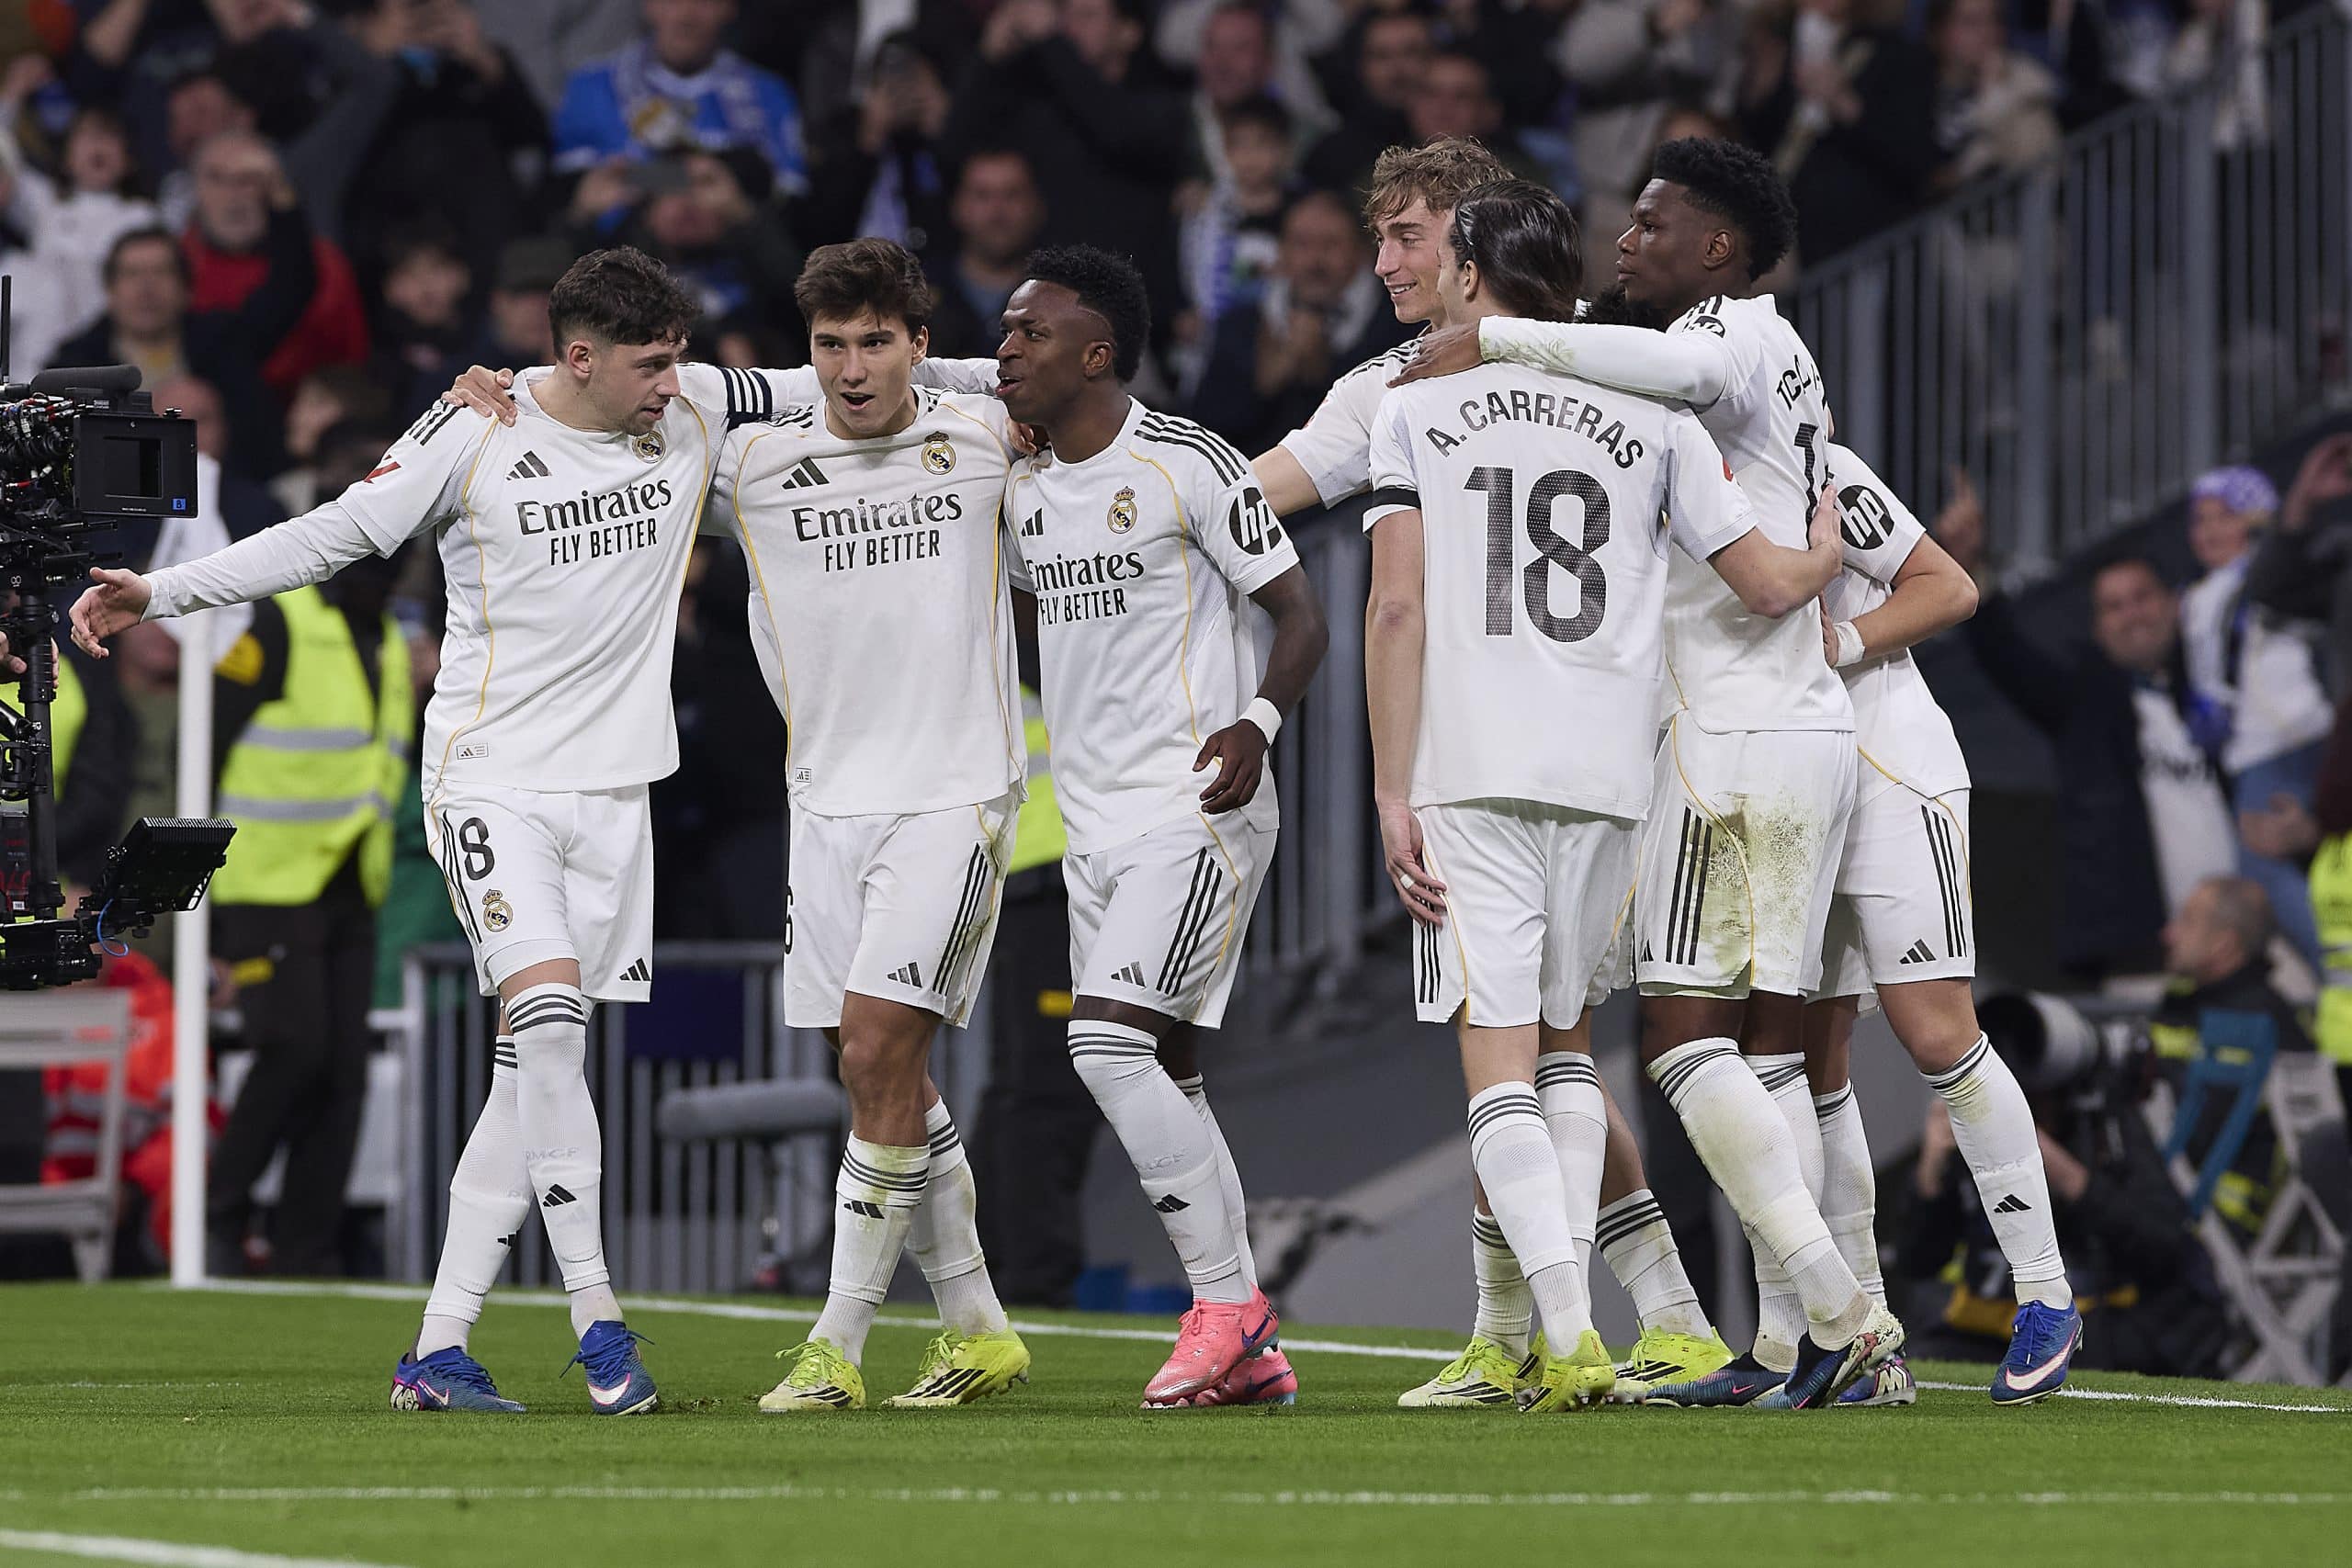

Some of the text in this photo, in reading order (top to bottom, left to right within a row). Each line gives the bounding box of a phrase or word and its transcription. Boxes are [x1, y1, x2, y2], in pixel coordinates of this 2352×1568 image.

[1425, 389, 1644, 469] A. CARRERAS
[514, 479, 673, 536] Emirates
[790, 492, 963, 542] Emirates
[1838, 488, 1894, 548] hp
[550, 517, 658, 566] FLY BETTER
[825, 529, 941, 572] FLY BETTER
[1464, 466, 1611, 643] 18
[1038, 587, 1128, 626] FLY BETTER
[459, 817, 495, 881] 8
